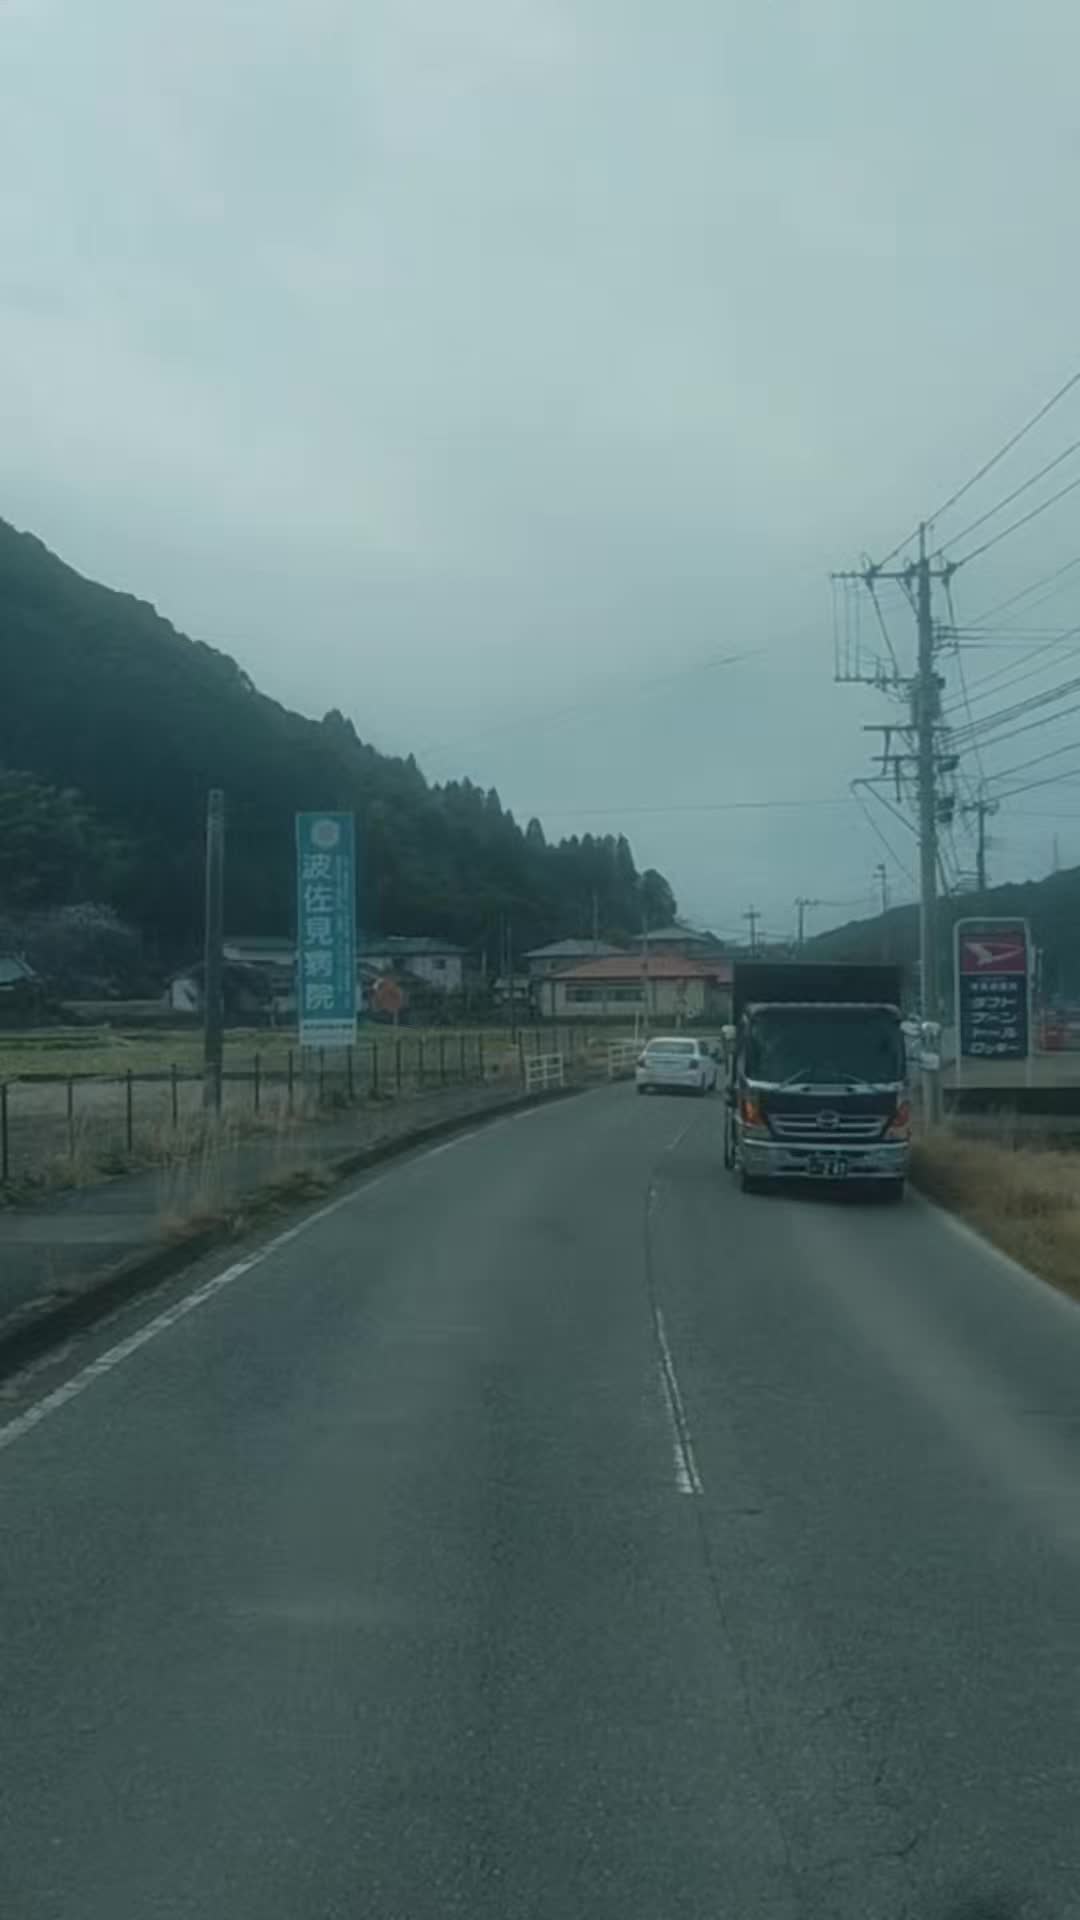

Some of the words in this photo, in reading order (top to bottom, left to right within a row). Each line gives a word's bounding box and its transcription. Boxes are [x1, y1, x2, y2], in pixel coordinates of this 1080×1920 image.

[302, 854, 335, 1010] 波佐見病院
[973, 1027, 1016, 1039] トール
